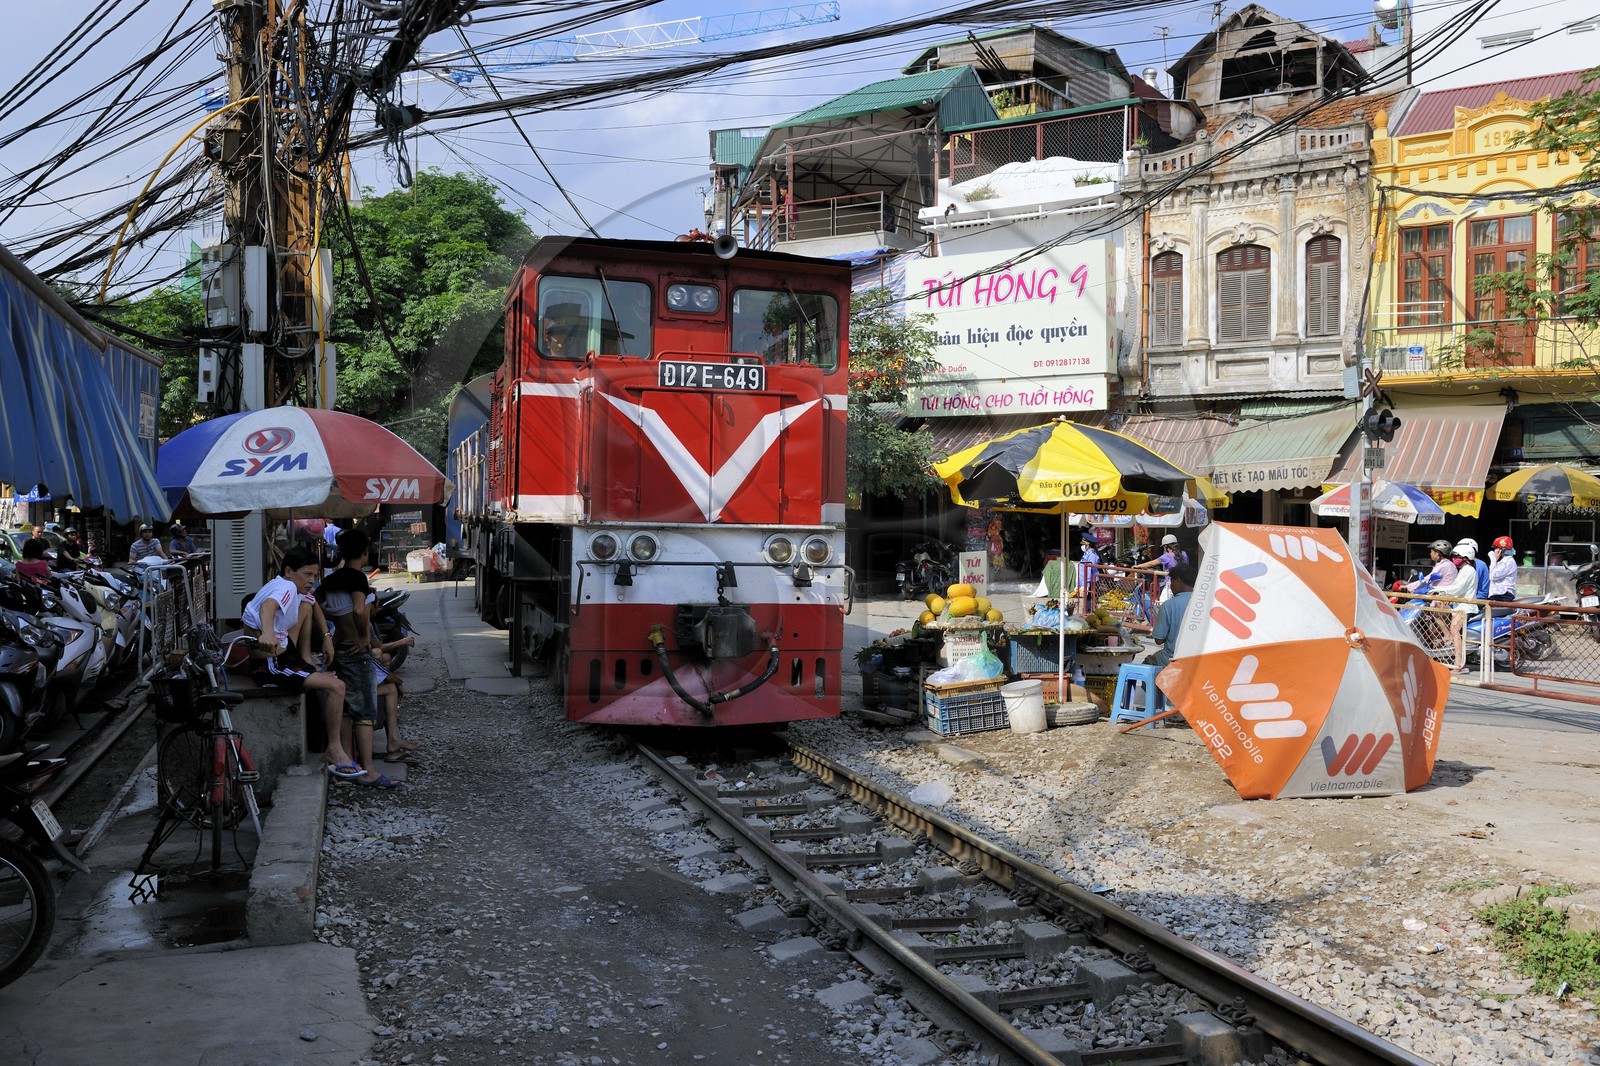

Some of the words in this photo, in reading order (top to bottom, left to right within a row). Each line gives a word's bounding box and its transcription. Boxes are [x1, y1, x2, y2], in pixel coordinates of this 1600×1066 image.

[923, 270, 964, 308] TÚI
[974, 260, 1059, 306] HỒNG
[1069, 263, 1089, 298] 9
[967, 327, 999, 348] hiệu
[1006, 324, 1034, 346] độc
[1040, 317, 1088, 344] quyền
[1046, 357, 1090, 367] 0912817138
[920, 394, 939, 411] TÚI
[943, 391, 981, 411] HỒNG
[985, 393, 1013, 408] CHO
[1053, 385, 1094, 405] HỒNG
[217, 452, 309, 477] SYM
[363, 478, 420, 502] SYM
[1062, 481, 1101, 497] 0199
[1094, 500, 1127, 513] 0199
[1590, 498, 1600, 506] 01
[1187, 553, 1219, 632] Vietnamobile
[1202, 679, 1264, 764] Vietnamobile
[1203, 723, 1233, 760] 092
[1310, 778, 1384, 793] Vietnamobile
